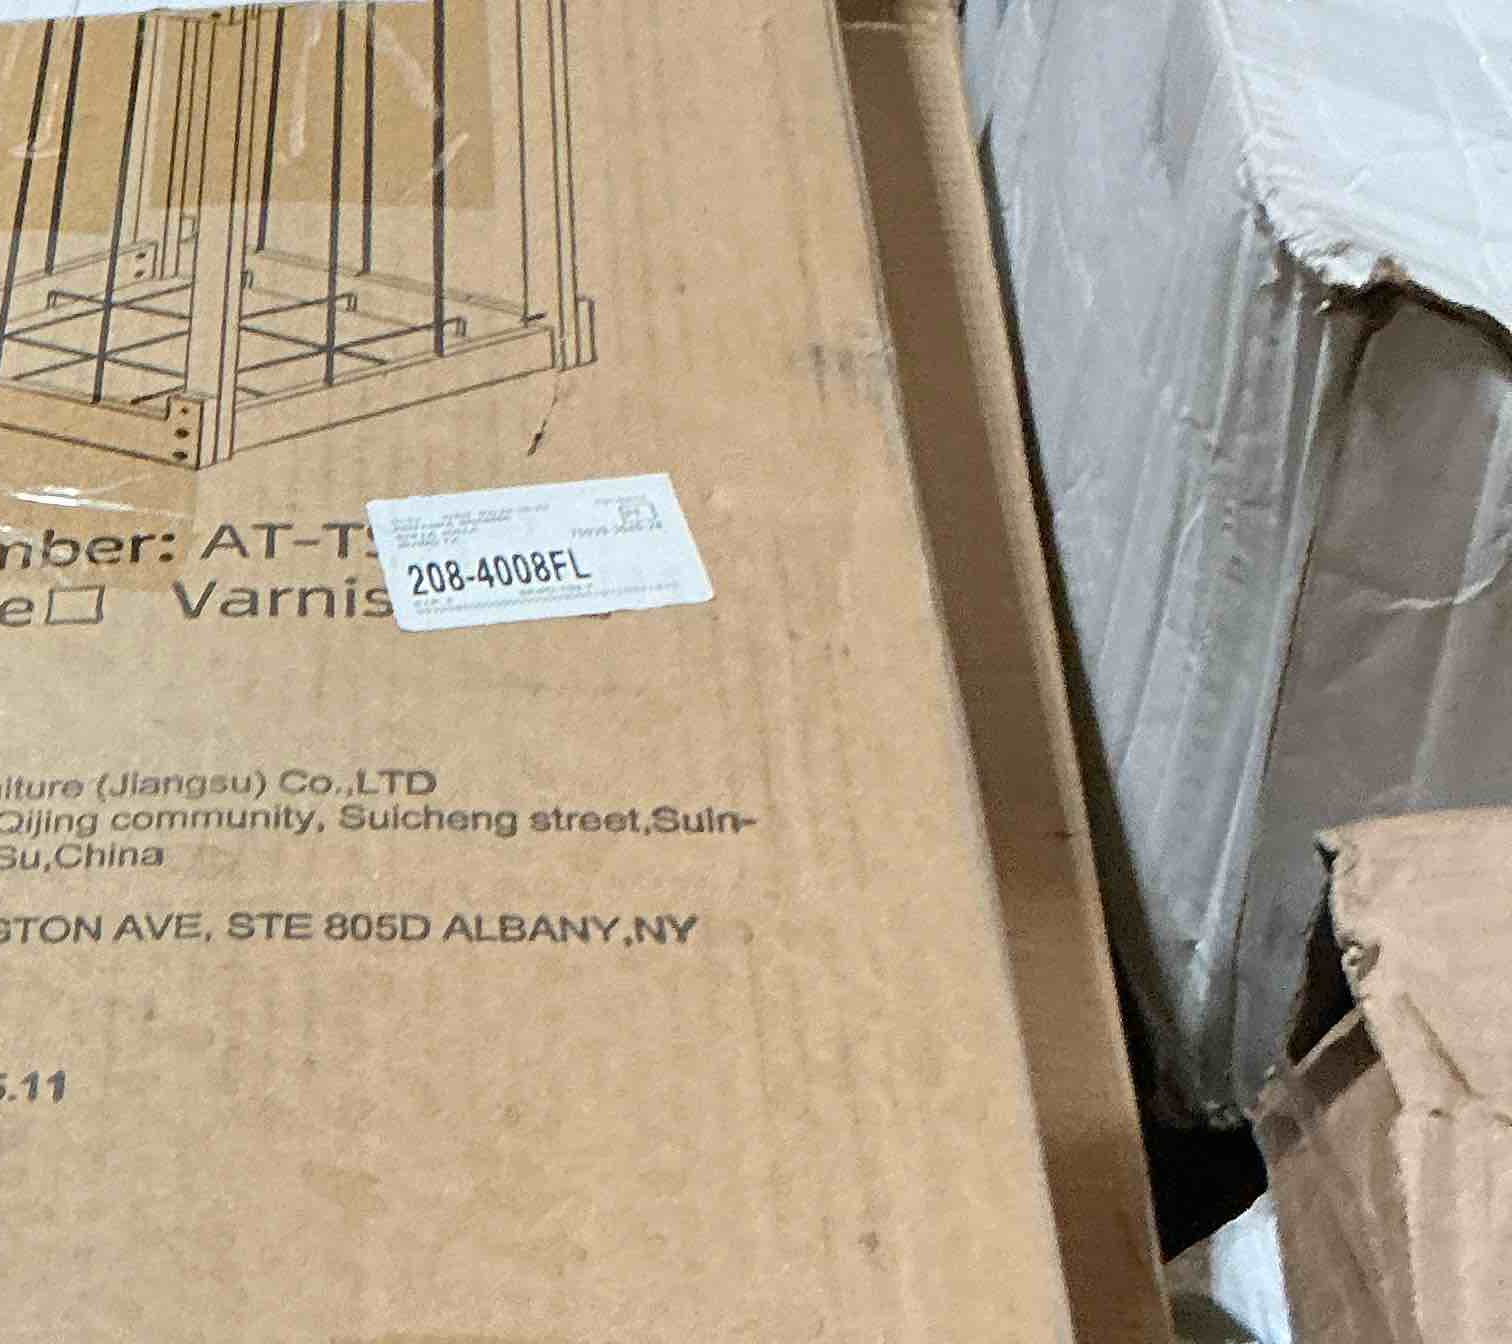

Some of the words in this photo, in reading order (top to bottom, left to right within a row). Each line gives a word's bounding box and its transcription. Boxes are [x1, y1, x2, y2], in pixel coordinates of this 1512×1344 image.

[199, 521, 378, 560] AT-T
[407, 547, 592, 596] 208-4008FL
[95, 768, 267, 803] (Jiangsu)
[278, 766, 438, 798] Co.,LTD
[110, 804, 326, 835] community,
[338, 803, 518, 838] Suicheng
[529, 805, 758, 837] street,Suin-
[112, 912, 214, 944] AVE,
[226, 911, 314, 941] STE
[323, 912, 433, 942] 805D
[441, 912, 700, 948] ALBANY,NY
